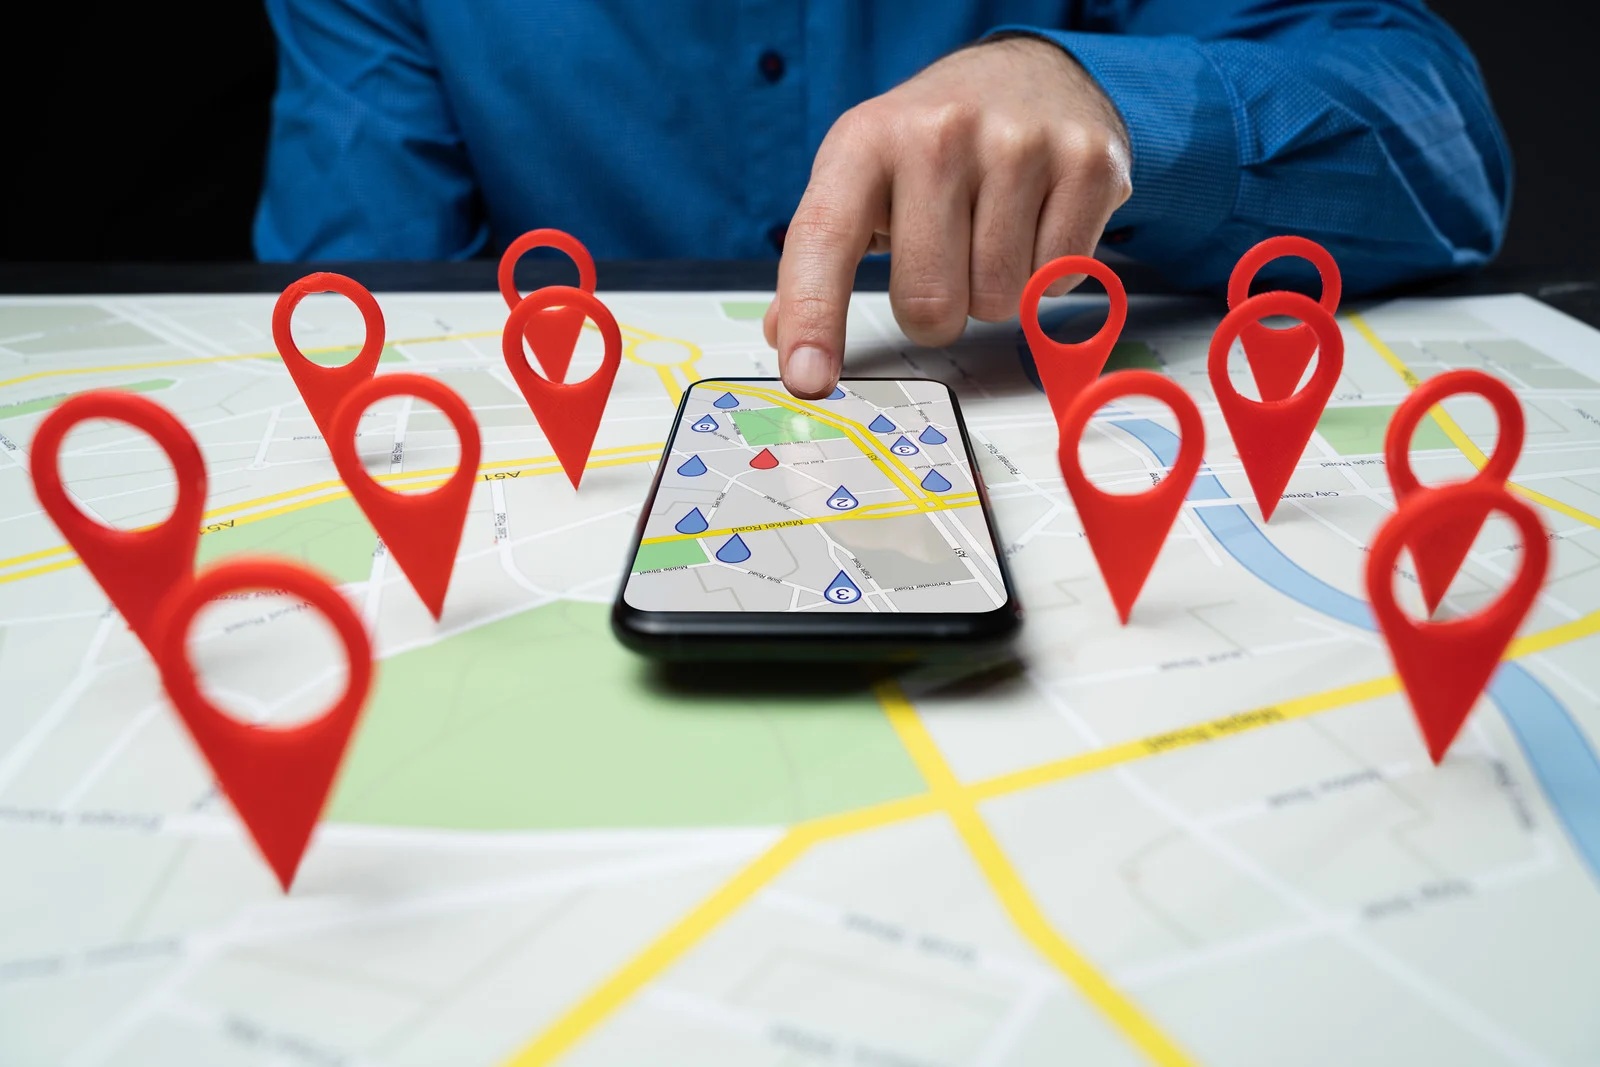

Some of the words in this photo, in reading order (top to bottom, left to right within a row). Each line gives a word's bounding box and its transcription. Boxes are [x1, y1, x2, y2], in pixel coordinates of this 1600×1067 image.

[700, 423, 710, 431] 5
[484, 471, 521, 481] A51
[1280, 492, 1314, 500] Street
[836, 499, 849, 508] 2
[731, 524, 762, 534] Road
[765, 519, 804, 530] Market
[953, 547, 968, 559] A51
[663, 565, 688, 573] Middle
[747, 570, 767, 579] Road
[767, 575, 783, 584] Side
[916, 581, 952, 589] Perimeter
[836, 588, 850, 600] 3
